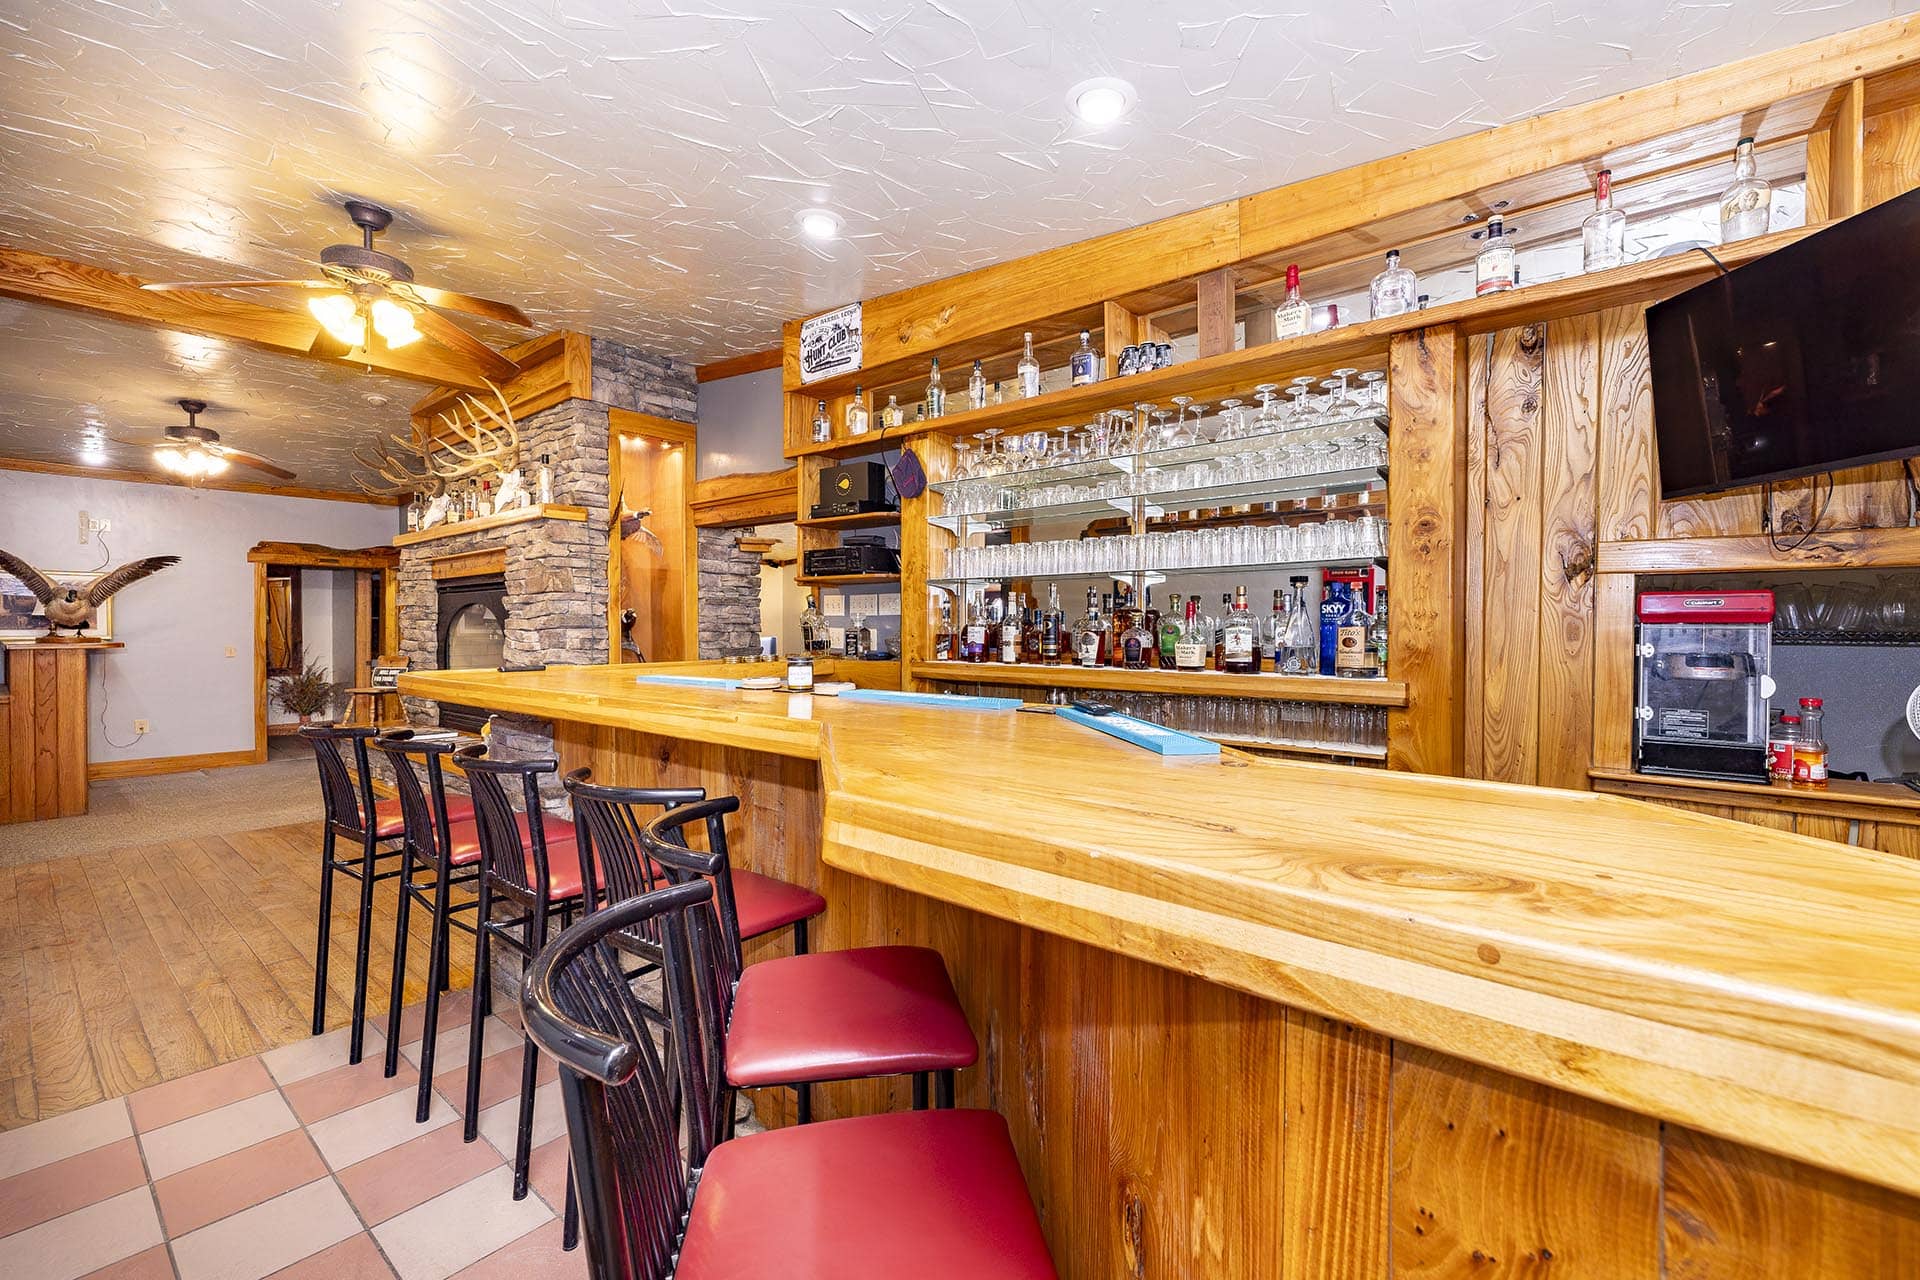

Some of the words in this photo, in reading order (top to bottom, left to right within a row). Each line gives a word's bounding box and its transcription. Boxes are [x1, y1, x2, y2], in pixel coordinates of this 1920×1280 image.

[804, 343, 828, 369] HUNT
[828, 329, 847, 349] CLUB
[1321, 604, 1346, 614] SKYY
[1340, 628, 1361, 637] Tito's
